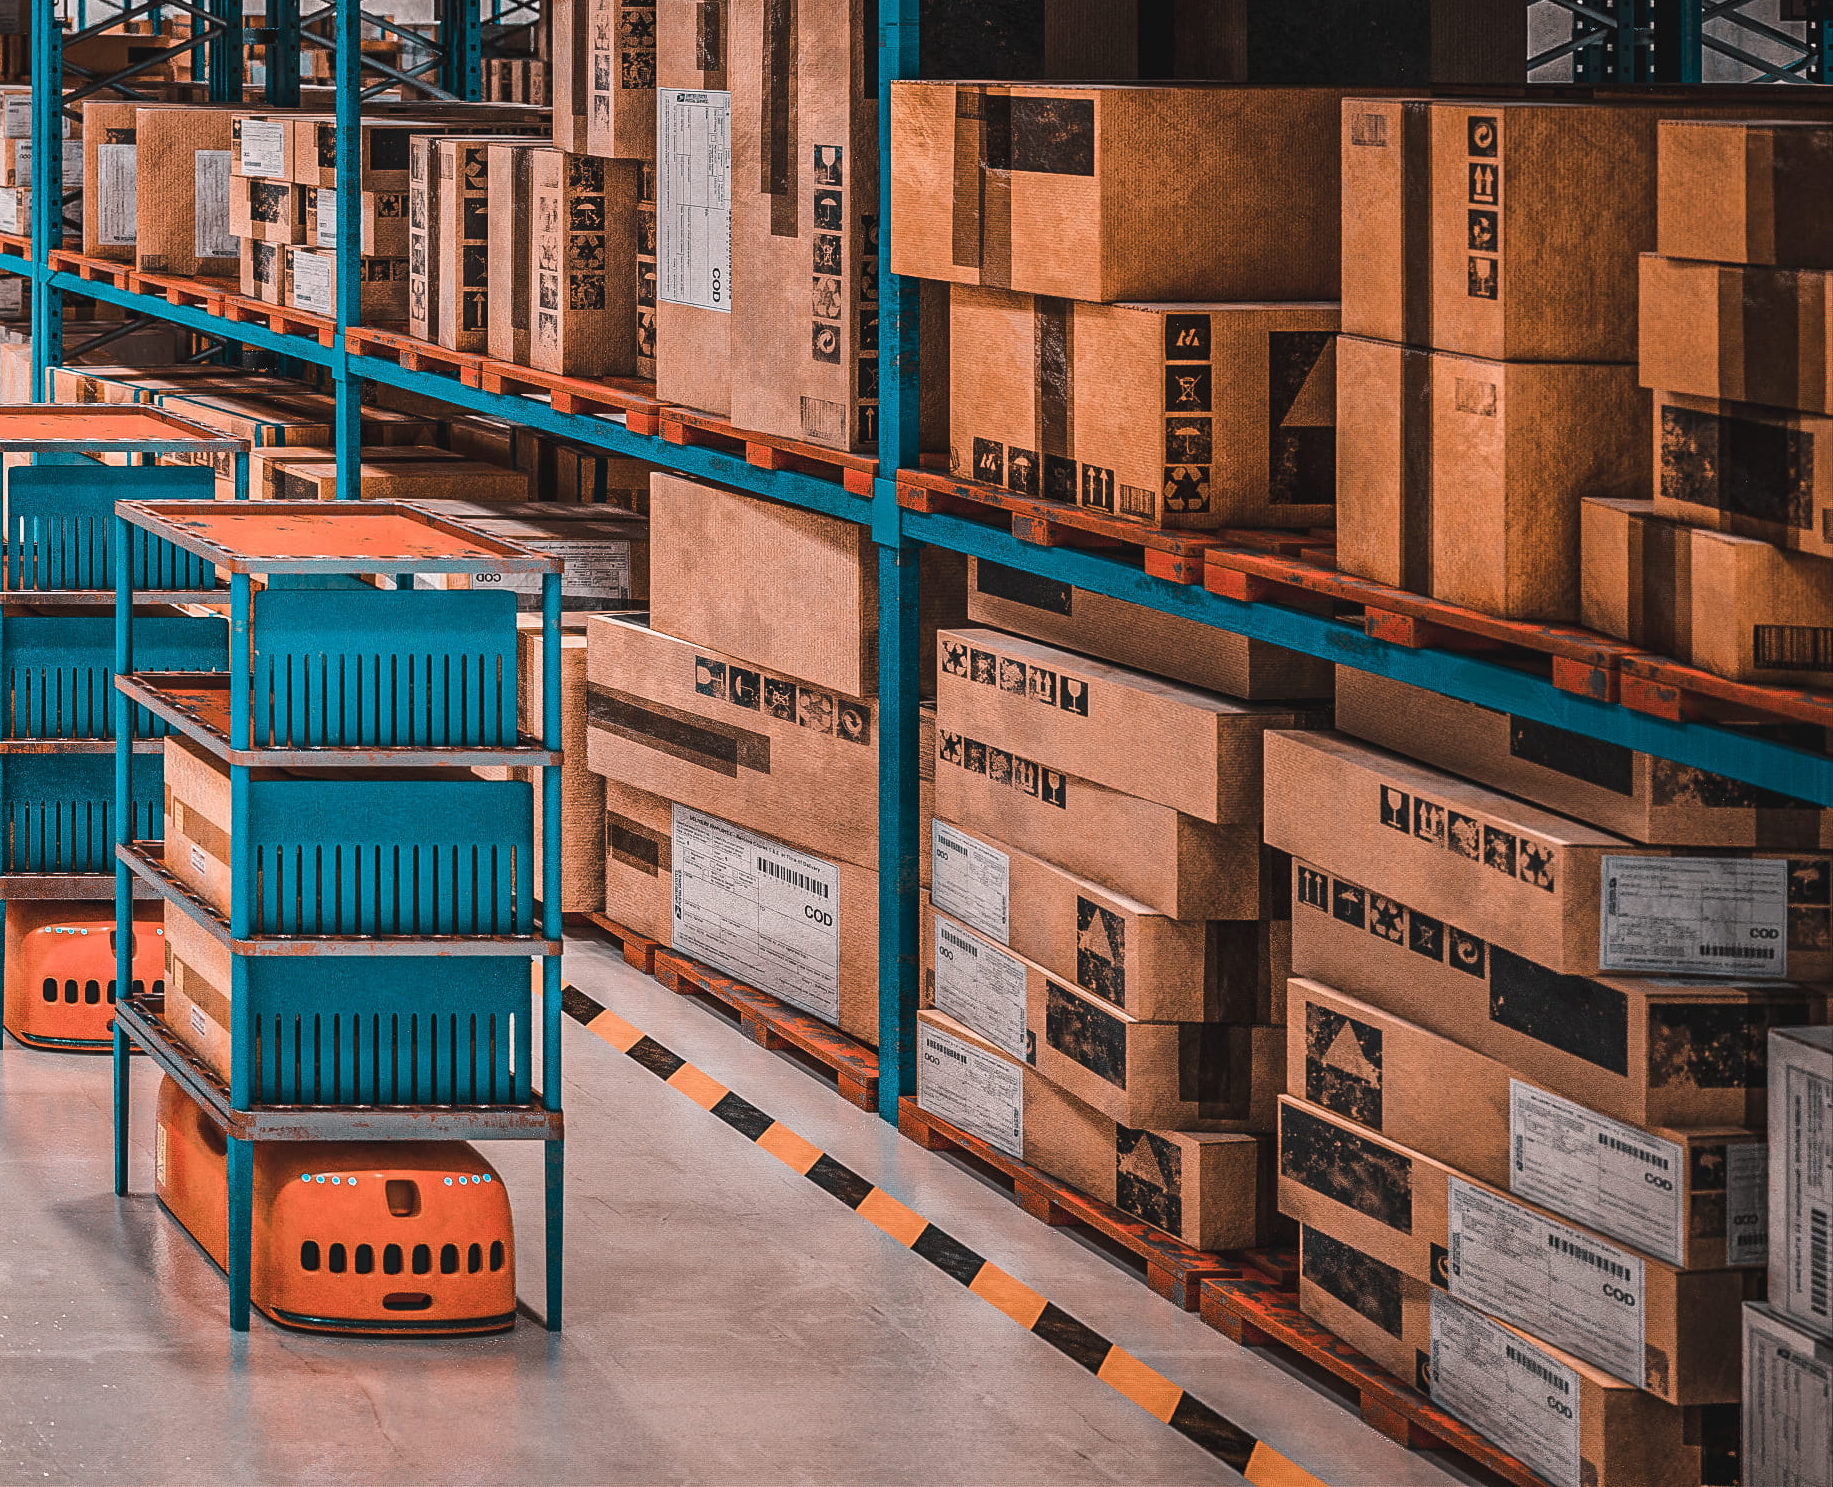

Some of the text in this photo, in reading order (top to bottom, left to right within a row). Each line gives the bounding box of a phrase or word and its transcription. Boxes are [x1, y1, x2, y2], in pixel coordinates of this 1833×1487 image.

[713, 268, 721, 302] COD
[804, 905, 833, 926] COD
[1750, 928, 1779, 939] COD
[1644, 1172, 1673, 1191] COD
[1602, 1283, 1635, 1307] COD
[1546, 1395, 1573, 1419] COD
